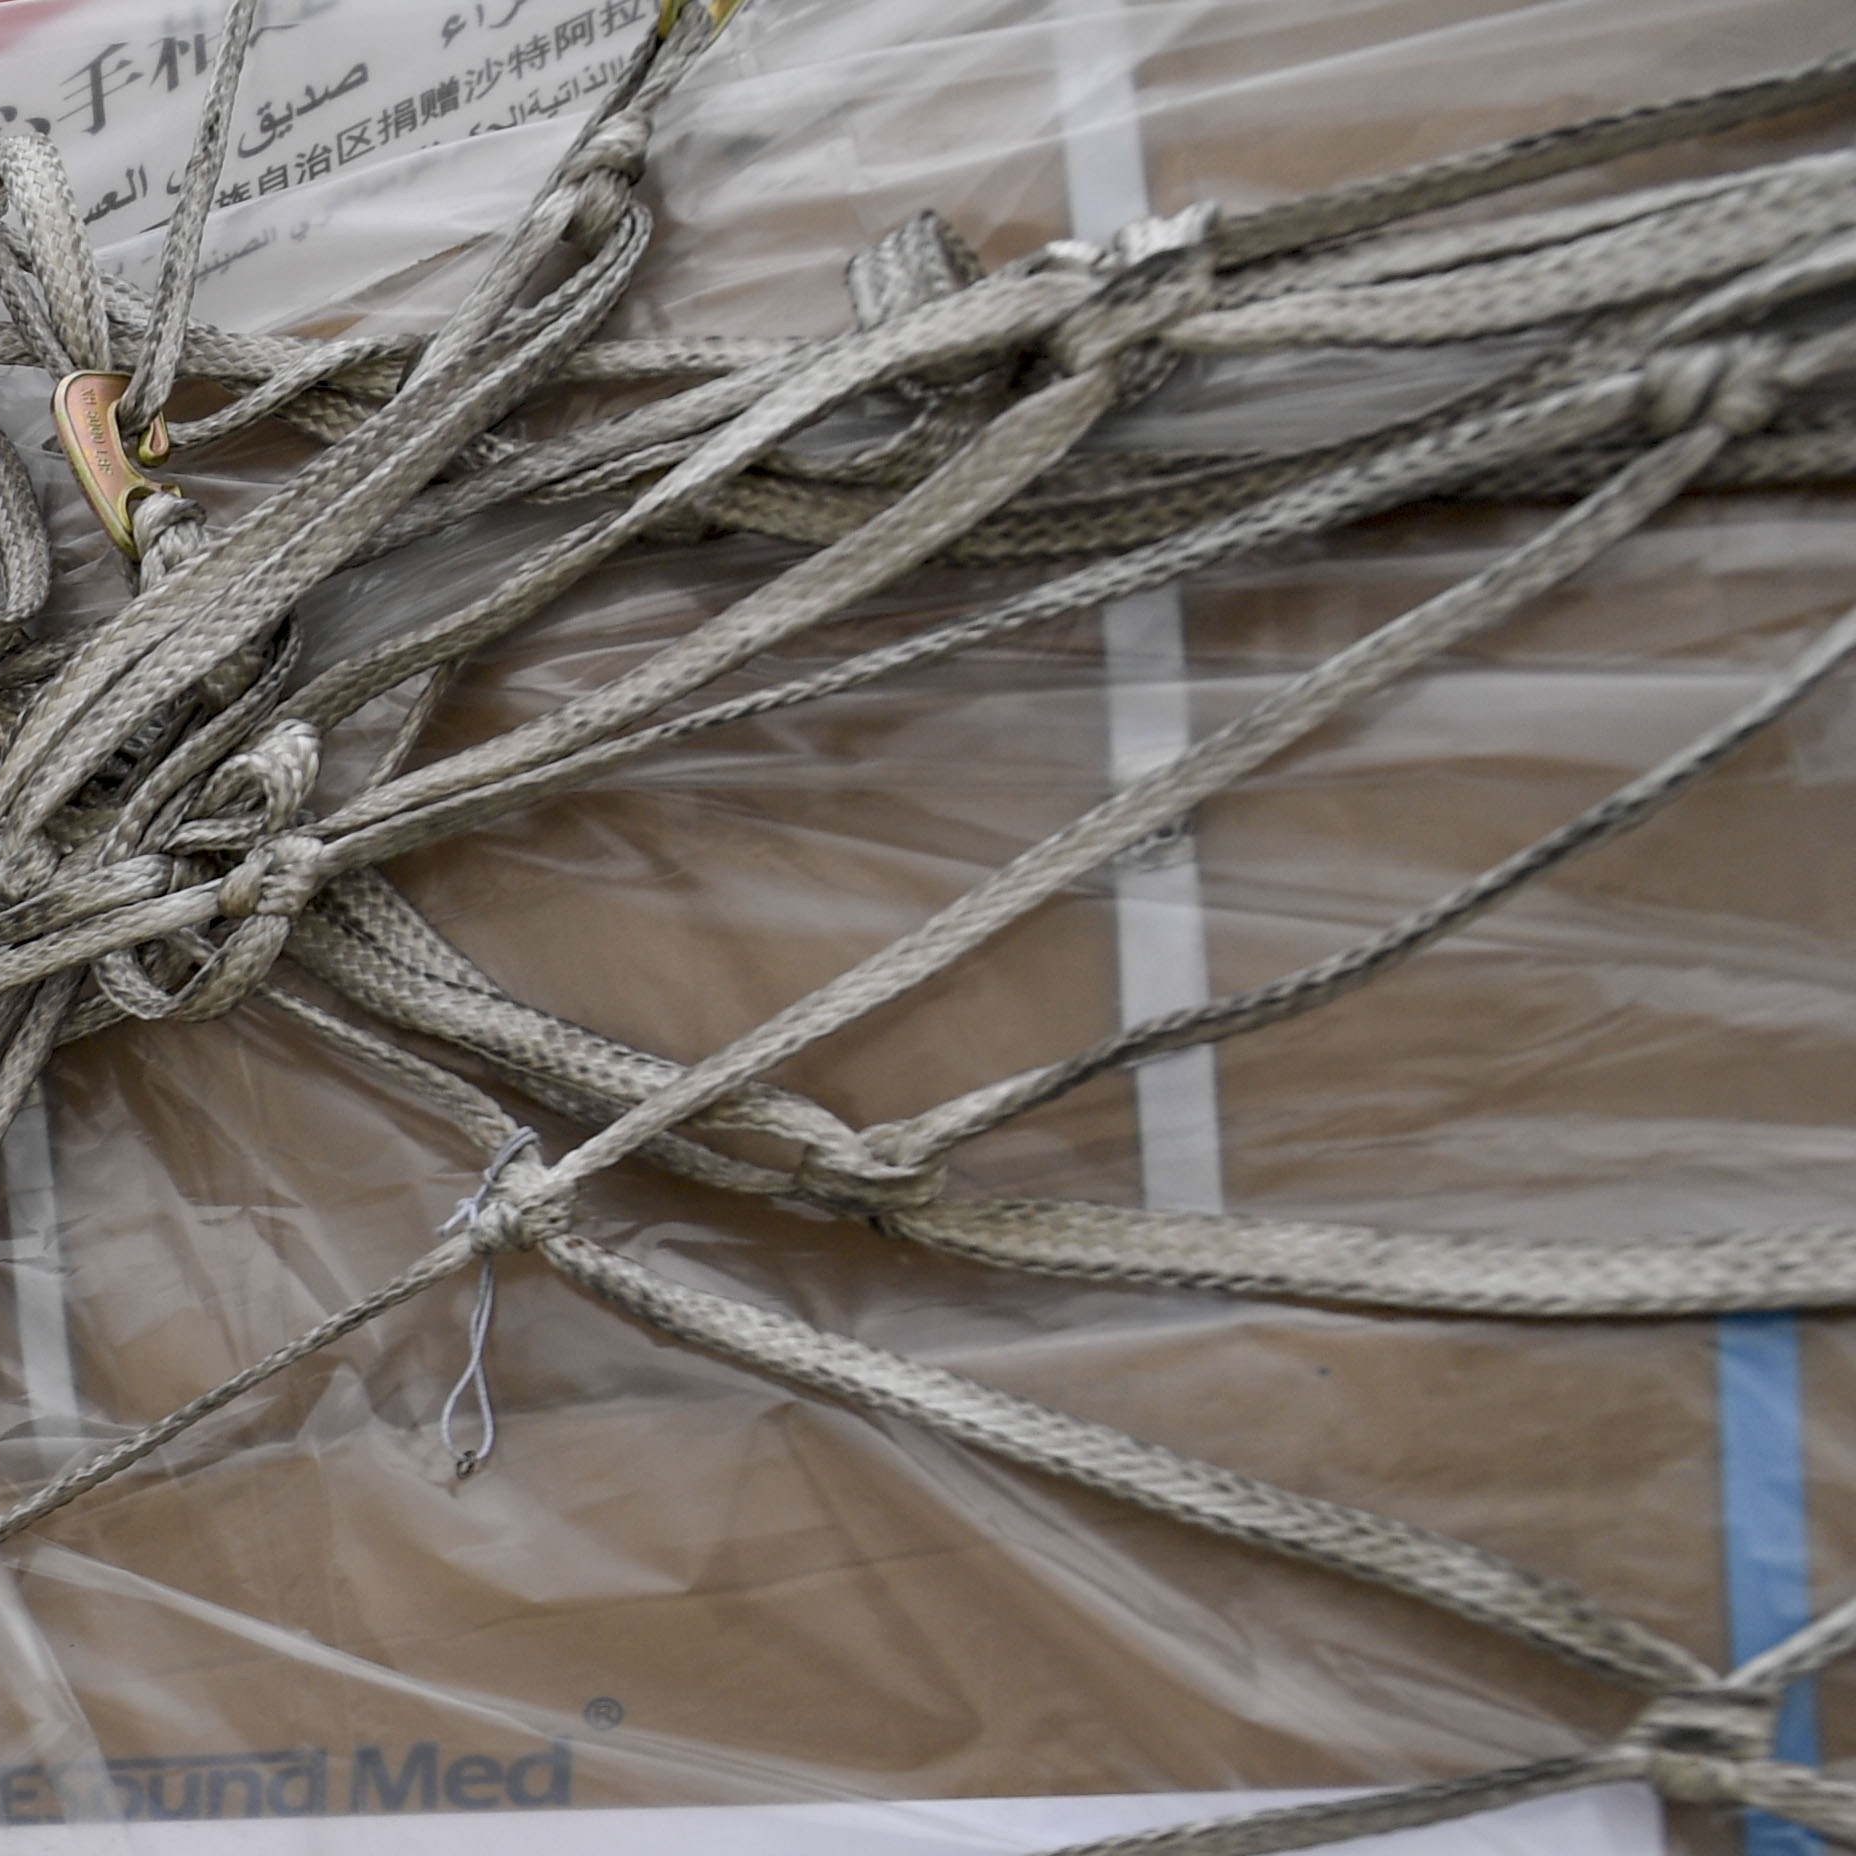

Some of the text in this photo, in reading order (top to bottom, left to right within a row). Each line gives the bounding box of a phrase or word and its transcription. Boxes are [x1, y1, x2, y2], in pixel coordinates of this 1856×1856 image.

[215, 0, 662, 209] 族自治区捐赠沙特阿拉
[350, 1735, 577, 1814] Med
